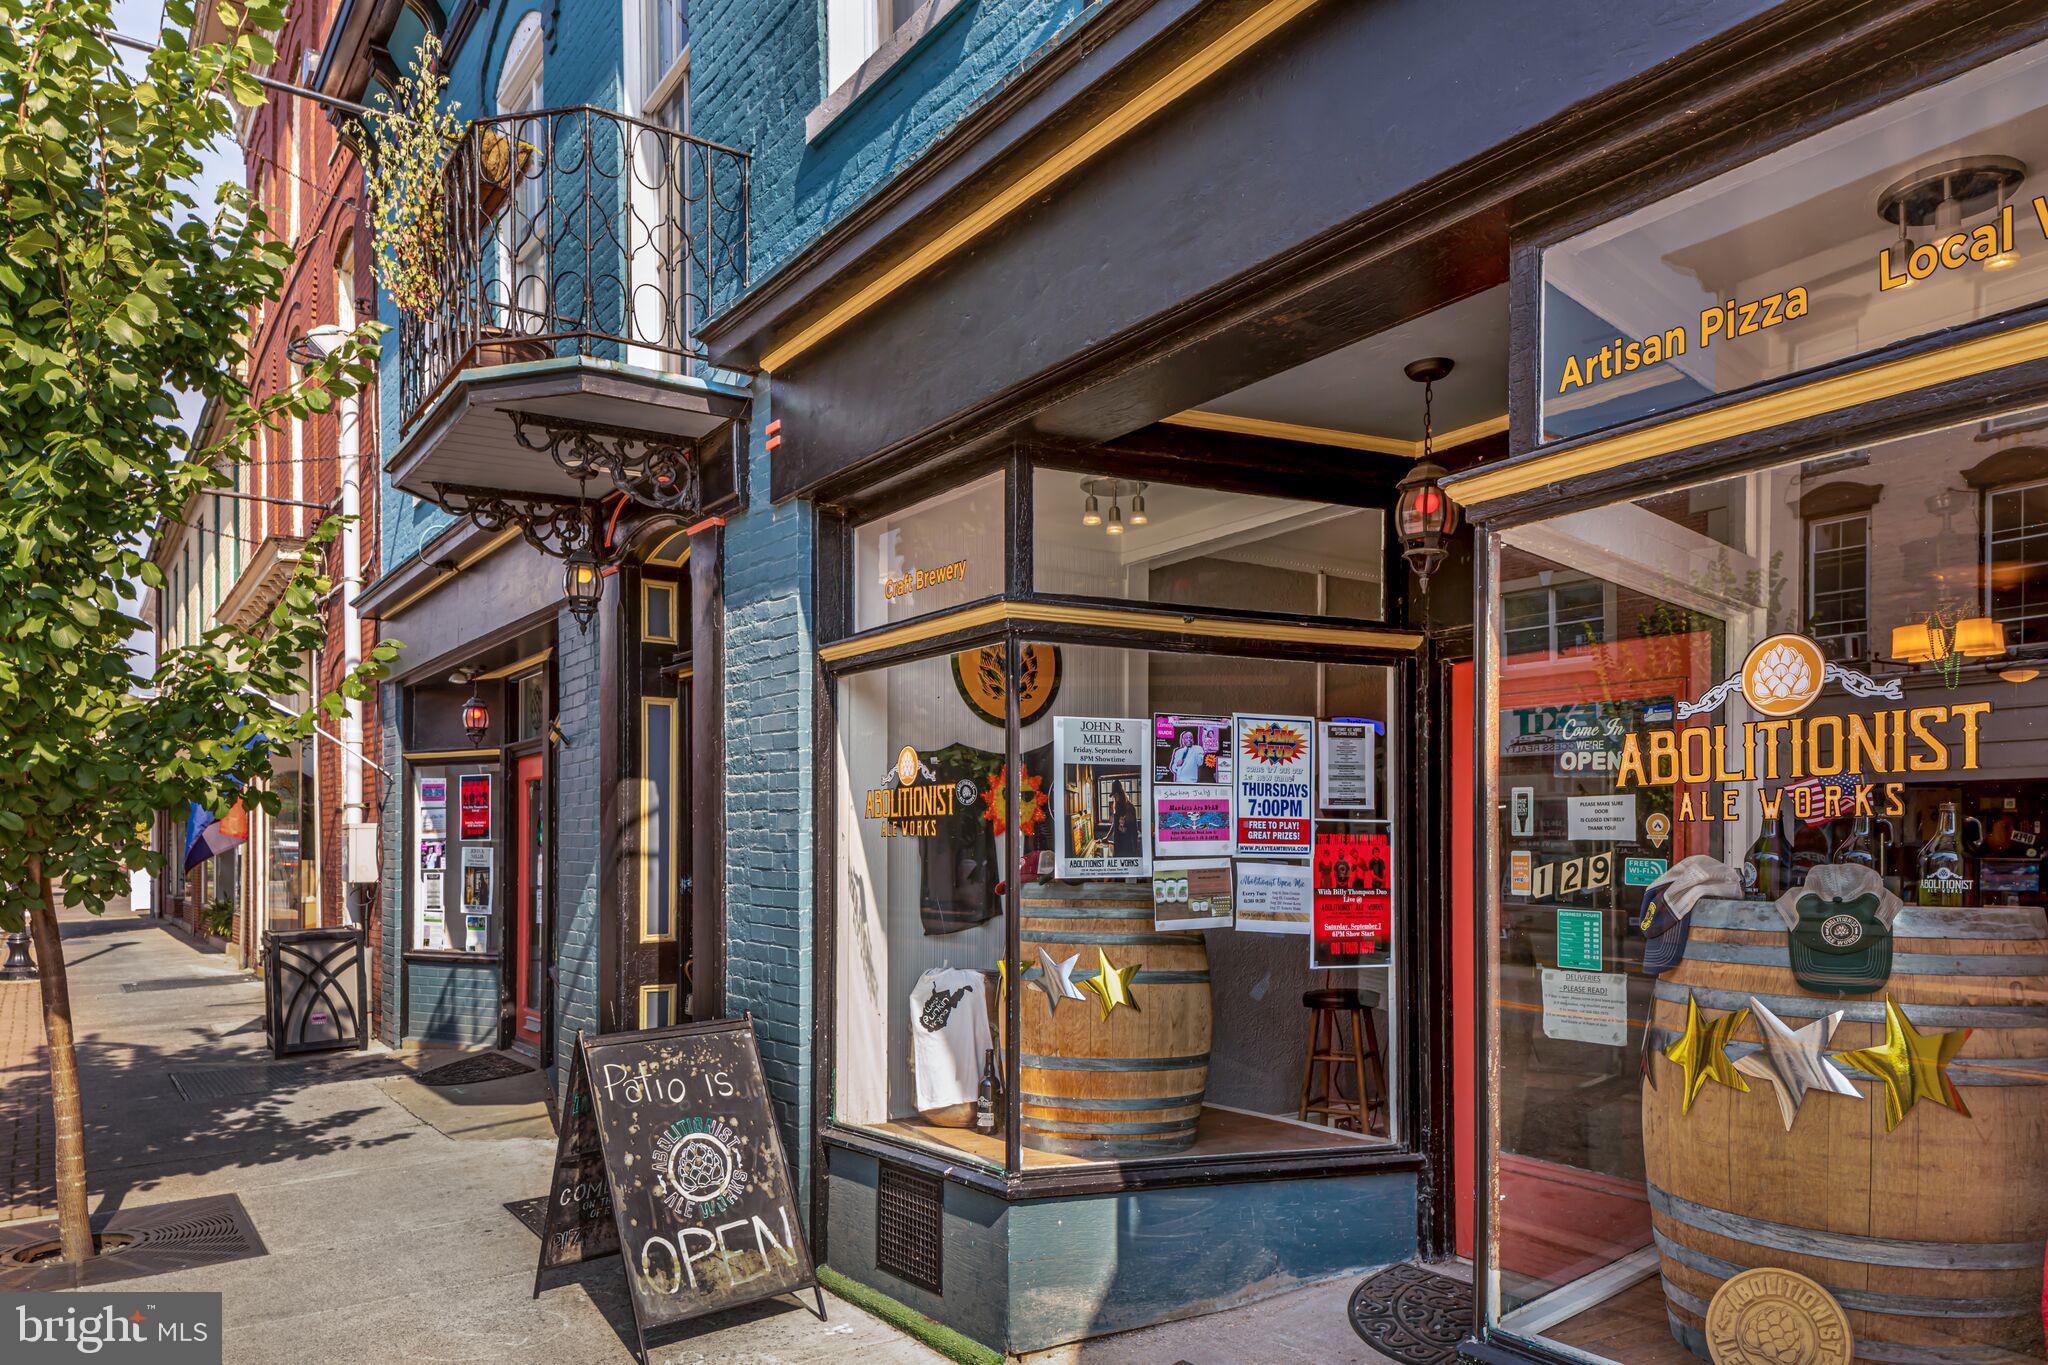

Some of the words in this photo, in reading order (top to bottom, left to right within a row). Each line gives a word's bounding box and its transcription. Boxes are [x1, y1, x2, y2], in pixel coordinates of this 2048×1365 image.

[1879, 204, 2014, 292] Local
[1557, 326, 1686, 393] Artisan
[1700, 285, 1809, 349] Pizza
[885, 572, 913, 600] Craft
[915, 559, 967, 591] Brewery
[1080, 721, 1111, 732] JOHN
[1115, 722, 1125, 732] R.
[1562, 718, 1599, 740] Come
[1603, 717, 1624, 737] In
[1084, 734, 1122, 744] MILLER
[1256, 728, 1295, 744] TEAM
[1615, 700, 1992, 788] ABOLITIONIST
[1094, 747, 1128, 756] September
[1258, 743, 1294, 758] FEUD
[1576, 740, 1604, 750] WE'RE
[1560, 751, 1622, 771] OPEN
[1242, 782, 1308, 798] THURSDAYS
[865, 783, 956, 819] ABOLITIONIST
[1248, 799, 1302, 817] 7:00PM
[1678, 790, 1740, 823] ALE
[1759, 782, 1905, 820] WORKS
[880, 821, 897, 837] ALE
[902, 820, 937, 837] WORKS
[1248, 820, 1266, 829] FREE
[1279, 821, 1299, 830] PLAY!
[1248, 832, 1271, 840] GREAT
[1272, 832, 1300, 840] PRIZES!
[1070, 860, 1105, 868] ABOLITIONIST
[1120, 859, 1139, 867] WORKS
[1920, 879, 1974, 890] ABOLITIONIST
[1331, 942, 1340, 954] ON
[1566, 974, 1600, 982] DELIVERIES
[652, 1116, 741, 1172] ABOLITIONIST
[664, 1191, 696, 1218] ALE
[641, 1206, 798, 1296] OPEN
[1726, 1274, 1843, 1356] ABOLITIONIST
